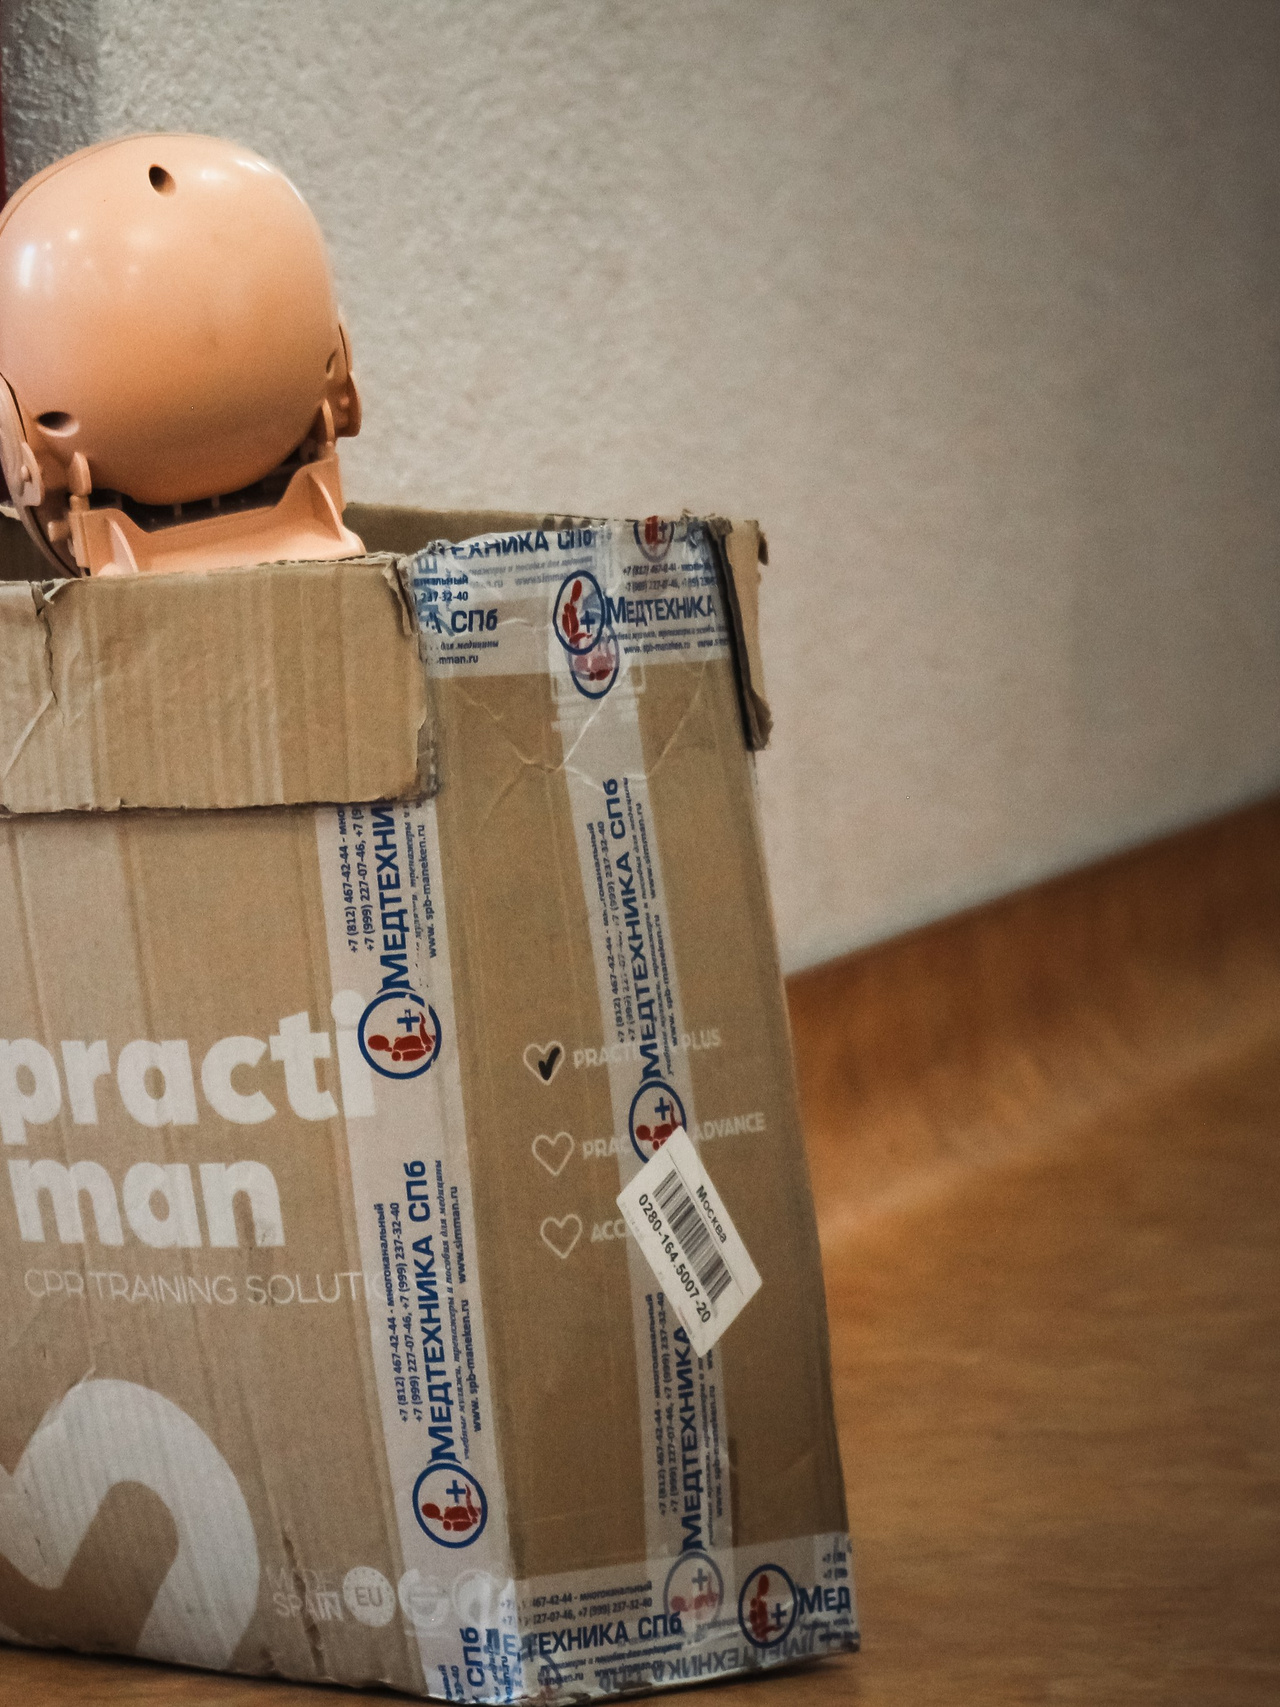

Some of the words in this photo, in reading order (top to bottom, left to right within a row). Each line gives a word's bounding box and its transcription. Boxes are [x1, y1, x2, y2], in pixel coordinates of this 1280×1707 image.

[451, 609, 498, 633] СПб
[605, 595, 717, 627] МЕДТЕХНИКА
[438, 654, 479, 665] mman.ru
[353, 822, 362, 836] +7
[603, 777, 626, 839] СПб
[339, 845, 353, 903] 467-42-44
[355, 840, 371, 901] 227-07-46,
[370, 801, 410, 988] МЕДТЕХНИ
[419, 824, 434, 920] spb-maneken.ru
[344, 905, 358, 935] (812)
[361, 904, 374, 934] (999)
[366, 936, 374, 951] +7
[350, 939, 358, 952] +7
[616, 851, 663, 1078] МЕДТЕХНИКА
[612, 997, 624, 1027] (812)
[8, 1158, 285, 1248] man
[403, 1159, 431, 1222] СПб
[433, 1159, 448, 1214] медицины
[389, 1202, 405, 1259] 237-32-40
[438, 1217, 449, 1237] для
[448, 1185, 468, 1283] www.simman.ru
[696, 1185, 727, 1243] Москва
[374, 1202, 395, 1306] многоканальный
[396, 1262, 410, 1292] (999)
[440, 1240, 453, 1283] пособия
[25, 1268, 84, 1298] CPR
[87, 1270, 237, 1304] TRAINING
[399, 1294, 410, 1309] +7
[387, 1316, 403, 1373] 467-42-44
[401, 1312, 419, 1373] 227-07-46,
[411, 1235, 458, 1460] МЕДТЕХНИКА
[446, 1296, 463, 1362] тренажеры
[458, 1299, 479, 1394] spb-maneken.ru
[394, 1376, 408, 1405] (812)
[399, 1408, 408, 1422] +7
[409, 1376, 423, 1405] (999)
[413, 1407, 423, 1422] +7
[674, 1326, 705, 1549] МЕДТЕХНИКА
[355, 1586, 384, 1607] EU
[638, 1611, 682, 1640] СПб
[459, 1626, 486, 1687] СПб
